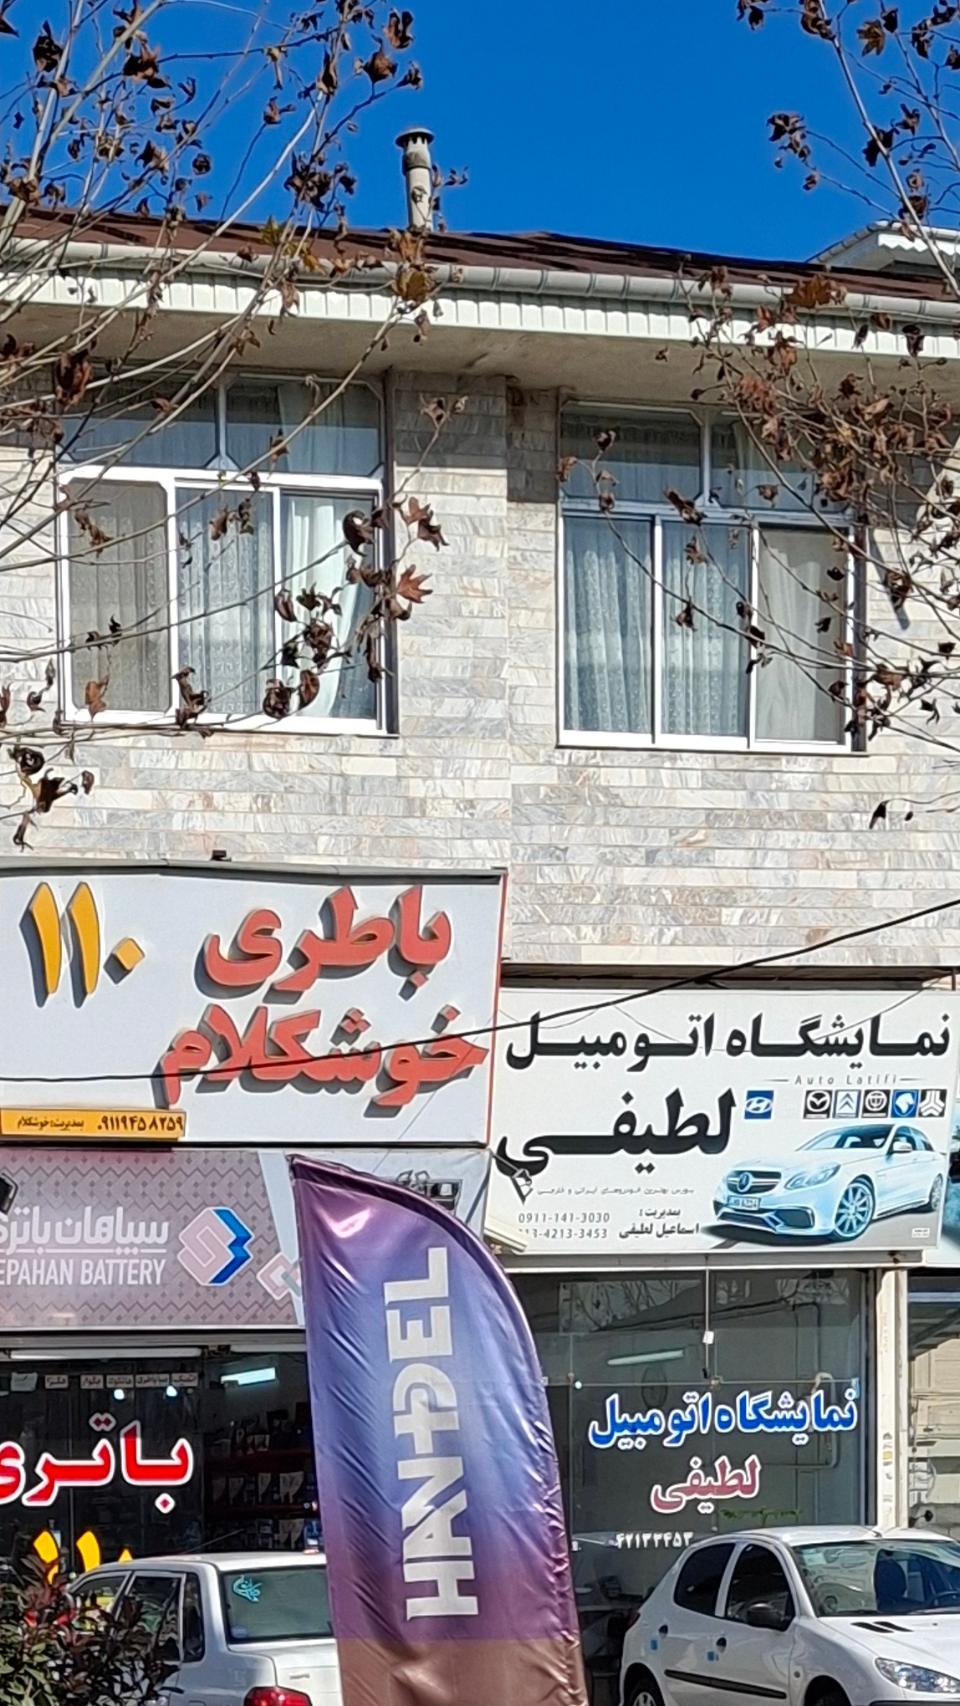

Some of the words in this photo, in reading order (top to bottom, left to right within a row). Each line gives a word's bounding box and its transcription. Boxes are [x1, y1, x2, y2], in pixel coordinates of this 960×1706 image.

[197, 885, 452, 1001] باطری
[154, 1004, 489, 1114] خوشکلام
[505, 1011, 716, 1072] اتومبیل
[725, 1012, 951, 1070] نمایشگاه
[794, 1074, 834, 1085] Auto
[846, 1074, 897, 1085] Latifi
[494, 1087, 738, 1178] لطیفی
[55, 1206, 170, 1255] سپاهان
[518, 1212, 610, 1223] 0911-141-3030
[619, 1223, 653, 1239] لطیفی
[656, 1223, 700, 1238] اسماعیل
[81, 1258, 167, 1286] BATTERY
[383, 1246, 480, 1622] HANDEL
[588, 1390, 713, 1450] اتومبیل
[714, 1387, 858, 1445] نمایشگاه
[650, 1454, 762, 1515] لطیفی
